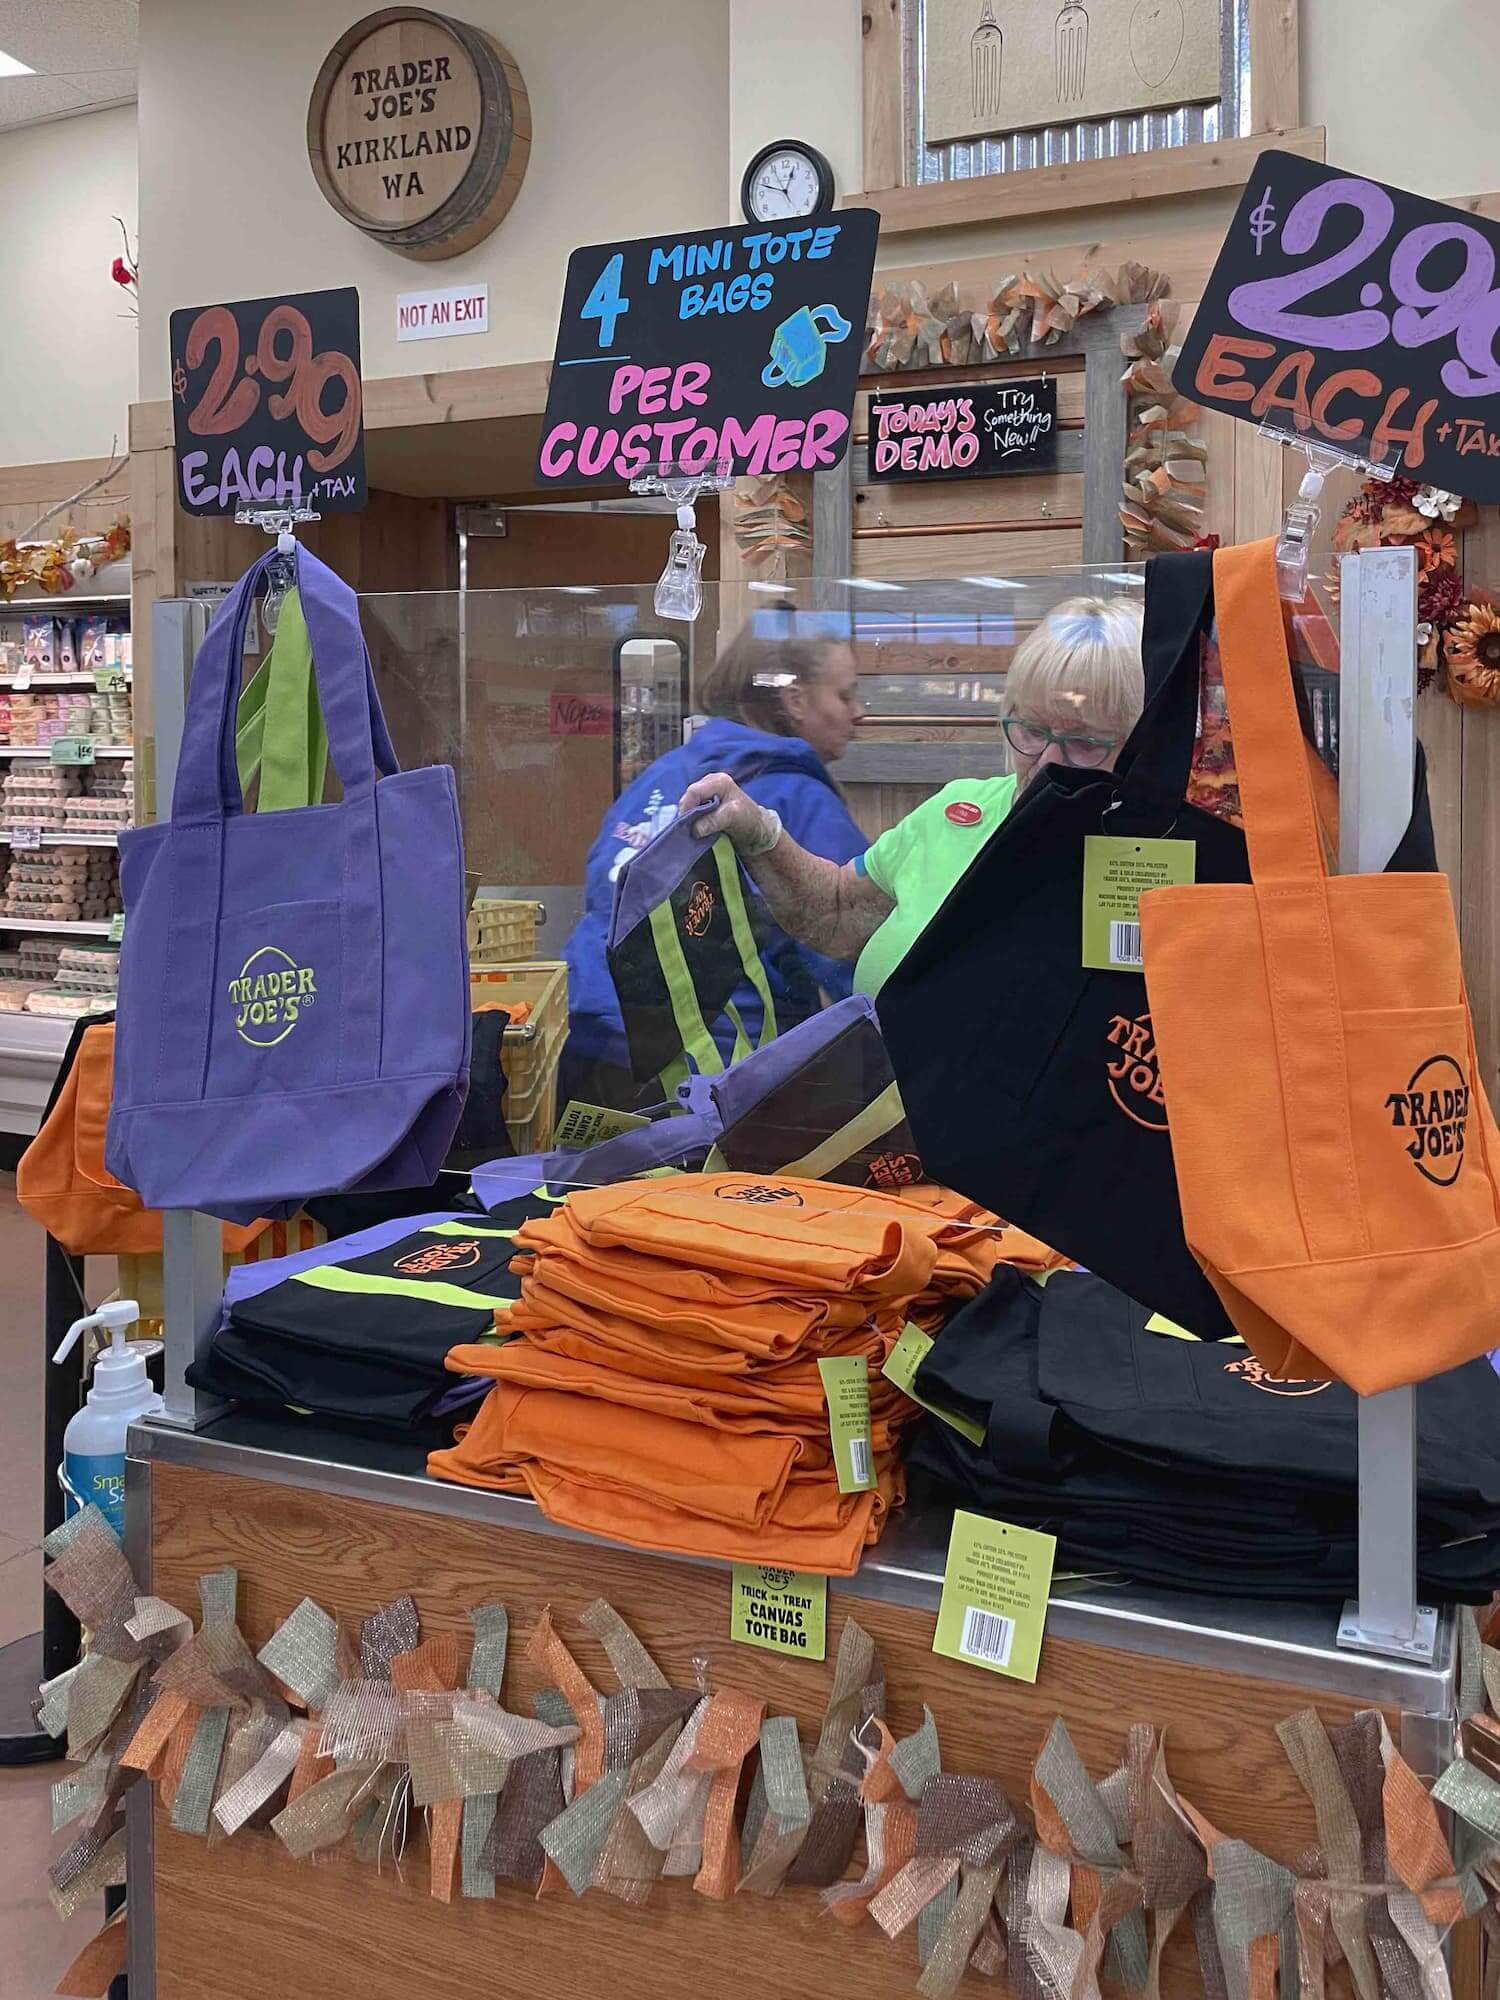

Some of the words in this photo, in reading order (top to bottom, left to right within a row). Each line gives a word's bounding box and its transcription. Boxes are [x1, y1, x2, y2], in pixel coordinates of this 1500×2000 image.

[351, 57, 452, 95] TRADER
[364, 88, 437, 121] JOE'S
[337, 125, 471, 169] KIRKLAND
[382, 172, 424, 199] WA
[580, 253, 629, 347] 4
[648, 240, 732, 284] MINI
[742, 225, 841, 269] TOTE
[679, 272, 774, 320] BAGS
[400, 304, 427, 329] NOT
[431, 302, 449, 324] AN
[455, 297, 485, 321] EXIT
[608, 362, 711, 415] PER
[997, 389, 1035, 412] Try
[1195, 334, 1439, 468] EACH
[872, 398, 976, 440] TODAY'S
[984, 408, 1052, 432] Something
[540, 409, 849, 479] CUSTOMER
[875, 432, 980, 472] DEMO
[181, 446, 304, 507] EACH
[228, 968, 317, 1003] TRADER
[1405, 1120, 1466, 1160] JOE'S
[741, 1584, 767, 1601] TRICK
[783, 1595, 812, 1610] TREAT
[750, 1602, 803, 1627] CANVAS
[745, 1619, 778, 1641] TOTE
[780, 1628, 806, 1648] BAG
